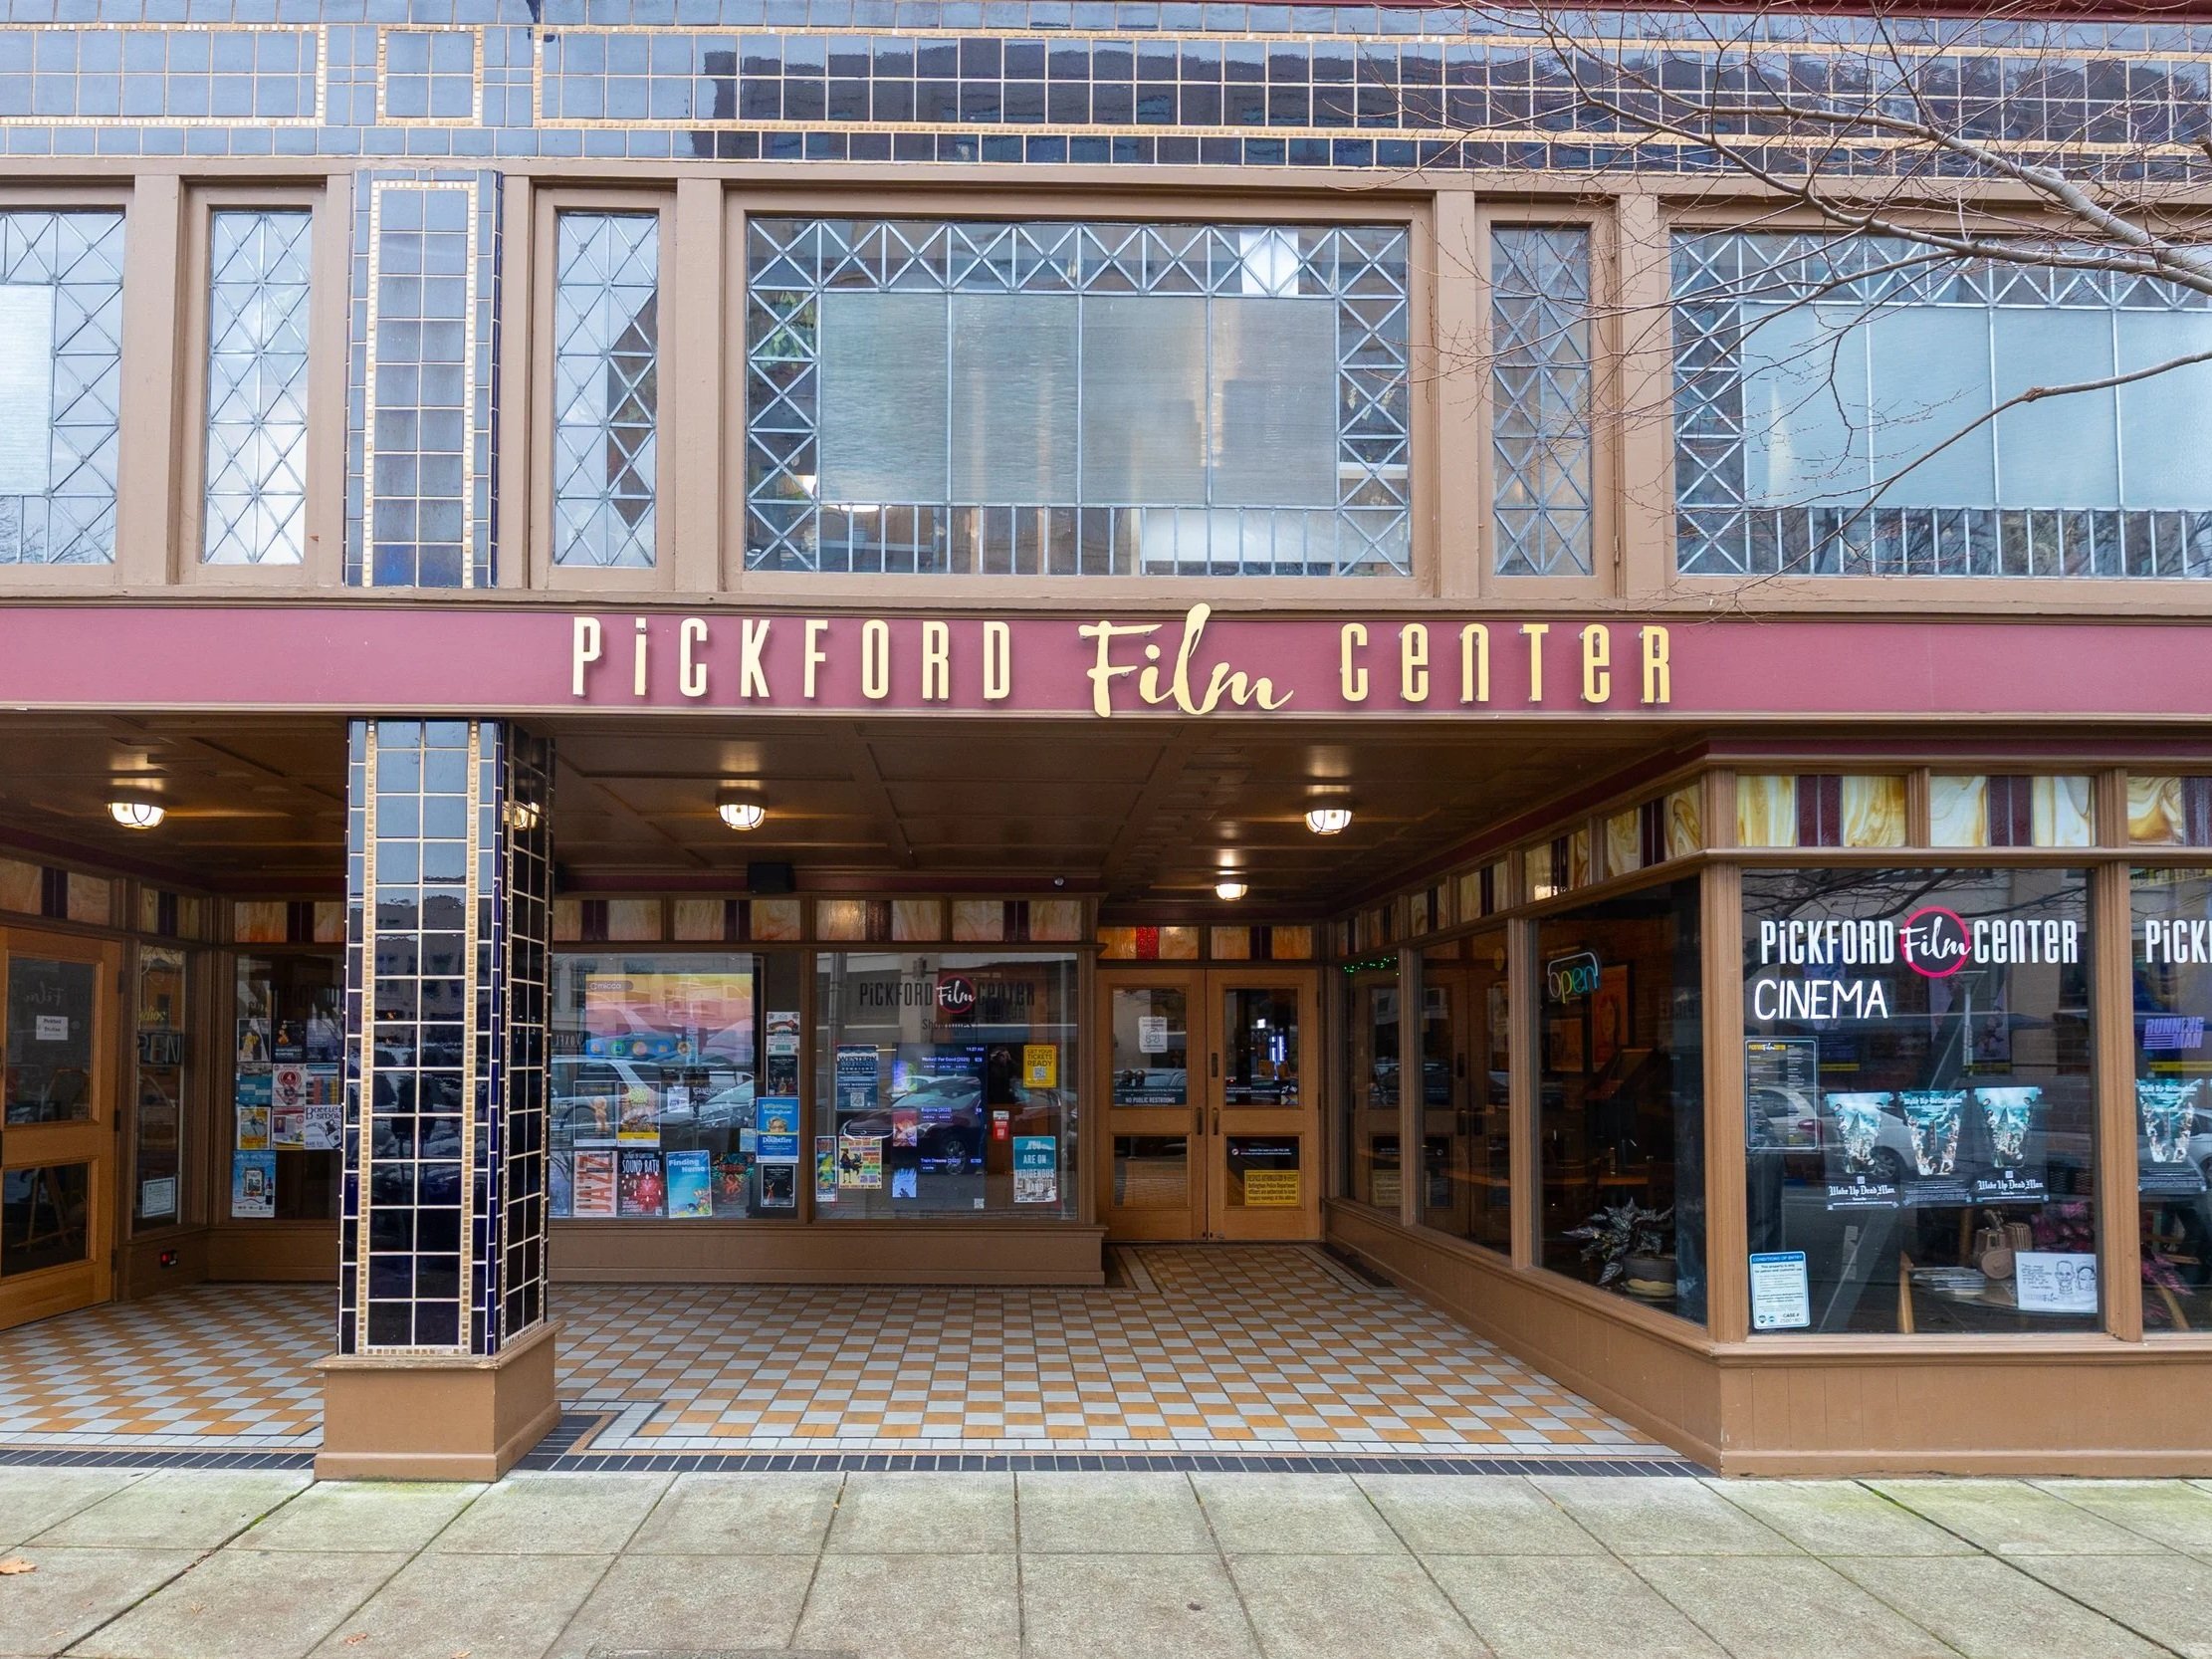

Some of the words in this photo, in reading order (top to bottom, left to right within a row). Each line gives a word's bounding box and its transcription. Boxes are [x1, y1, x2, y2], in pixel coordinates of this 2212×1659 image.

[1077, 600, 1294, 719] Film
[1899, 914, 1971, 964] Film
[1548, 963, 1599, 1004] open
[936, 979, 977, 1007] Film
[1754, 979, 1888, 1020] CINEMA
[2144, 1017, 2205, 1034] RUNNING
[2172, 1033, 2203, 1049] MAN
[622, 1159, 643, 1173] SOUND
[644, 1159, 660, 1173] BATH
[668, 1158, 700, 1167] Finding
[1022, 1154, 1036, 1164] ARE
[1037, 1154, 1046, 1164] ON
[1016, 1168, 1055, 1179] INDIGENOUS
[1849, 1185, 1860, 1197] Up
[1860, 1185, 1878, 1195] Dead
[1876, 1184, 1895, 1196] Man
[1998, 1180, 2008, 1191] Up
[2008, 1180, 2026, 1190] Dead
[2025, 1179, 2044, 1190] Man
